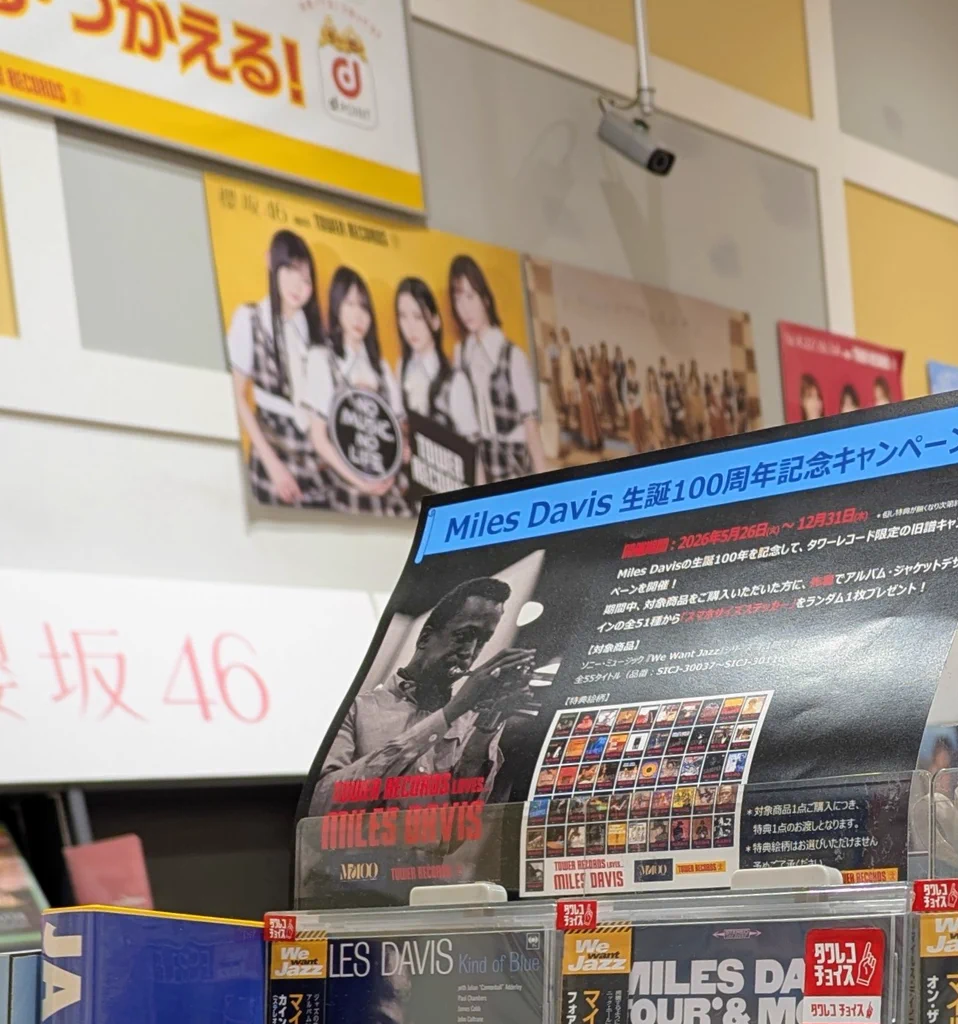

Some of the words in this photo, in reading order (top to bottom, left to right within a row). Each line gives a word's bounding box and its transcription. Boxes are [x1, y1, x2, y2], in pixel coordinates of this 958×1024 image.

[444, 506, 520, 544] Miles
[527, 490, 612, 531] Davis
[616, 567, 647, 580] Miles
[332, 778, 382, 804] TOWER
[384, 773, 452, 799] RECORDS
[321, 807, 400, 850] MILES
[404, 801, 485, 845] DAVIS
[554, 860, 578, 870] TOWER
[554, 873, 585, 890] MILES
[590, 870, 624, 888] DAVIS
[329, 943, 370, 978] LES
[381, 938, 454, 977] DAVIS
[458, 954, 488, 974] Kind
[491, 953, 507, 972] of
[509, 951, 541, 972] Blue
[567, 956, 627, 972] Jazz
[814, 942, 857, 965] タワレコ
[274, 963, 324, 977] Jazz
[629, 957, 745, 996] MILES
[814, 965, 856, 987] チョイス
[811, 1003, 836, 1017] タワレコ
[838, 1003, 864, 1018] チョイス
